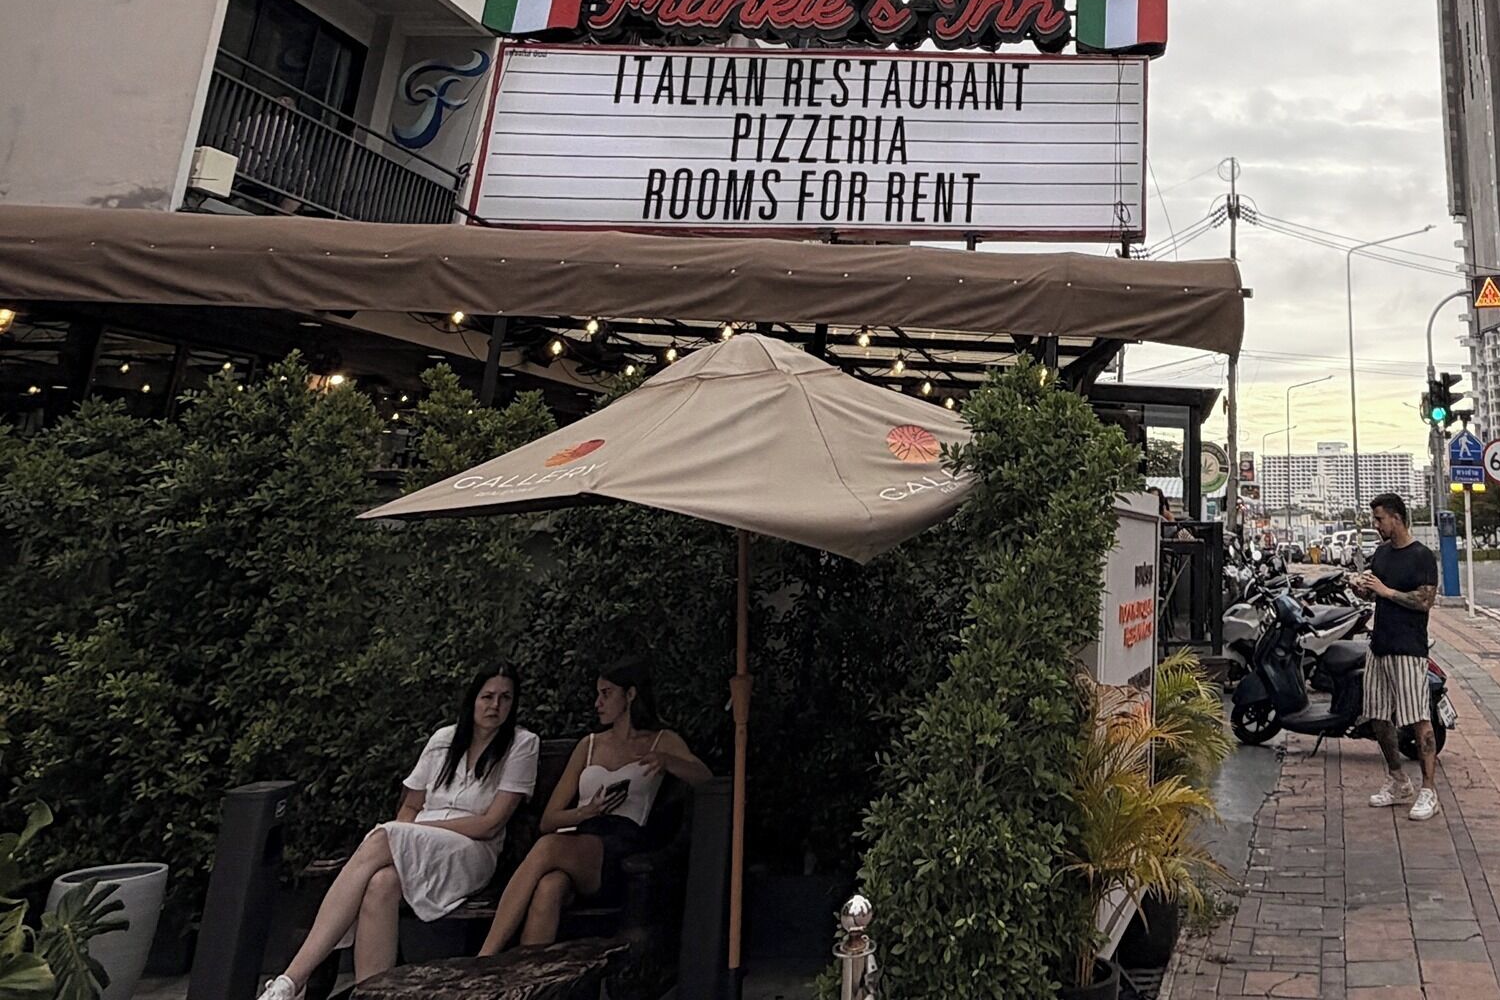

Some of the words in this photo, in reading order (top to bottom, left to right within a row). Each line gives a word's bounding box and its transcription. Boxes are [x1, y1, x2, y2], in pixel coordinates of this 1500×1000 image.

[614, 55, 767, 106] ITALIAN
[783, 59, 1030, 110] RESTAURANT
[731, 113, 908, 164] PIZZERIA
[643, 168, 781, 220] ROOMS
[797, 170, 868, 221] FOR
[886, 172, 981, 223] RENT
[453, 461, 608, 490] GALLERY
